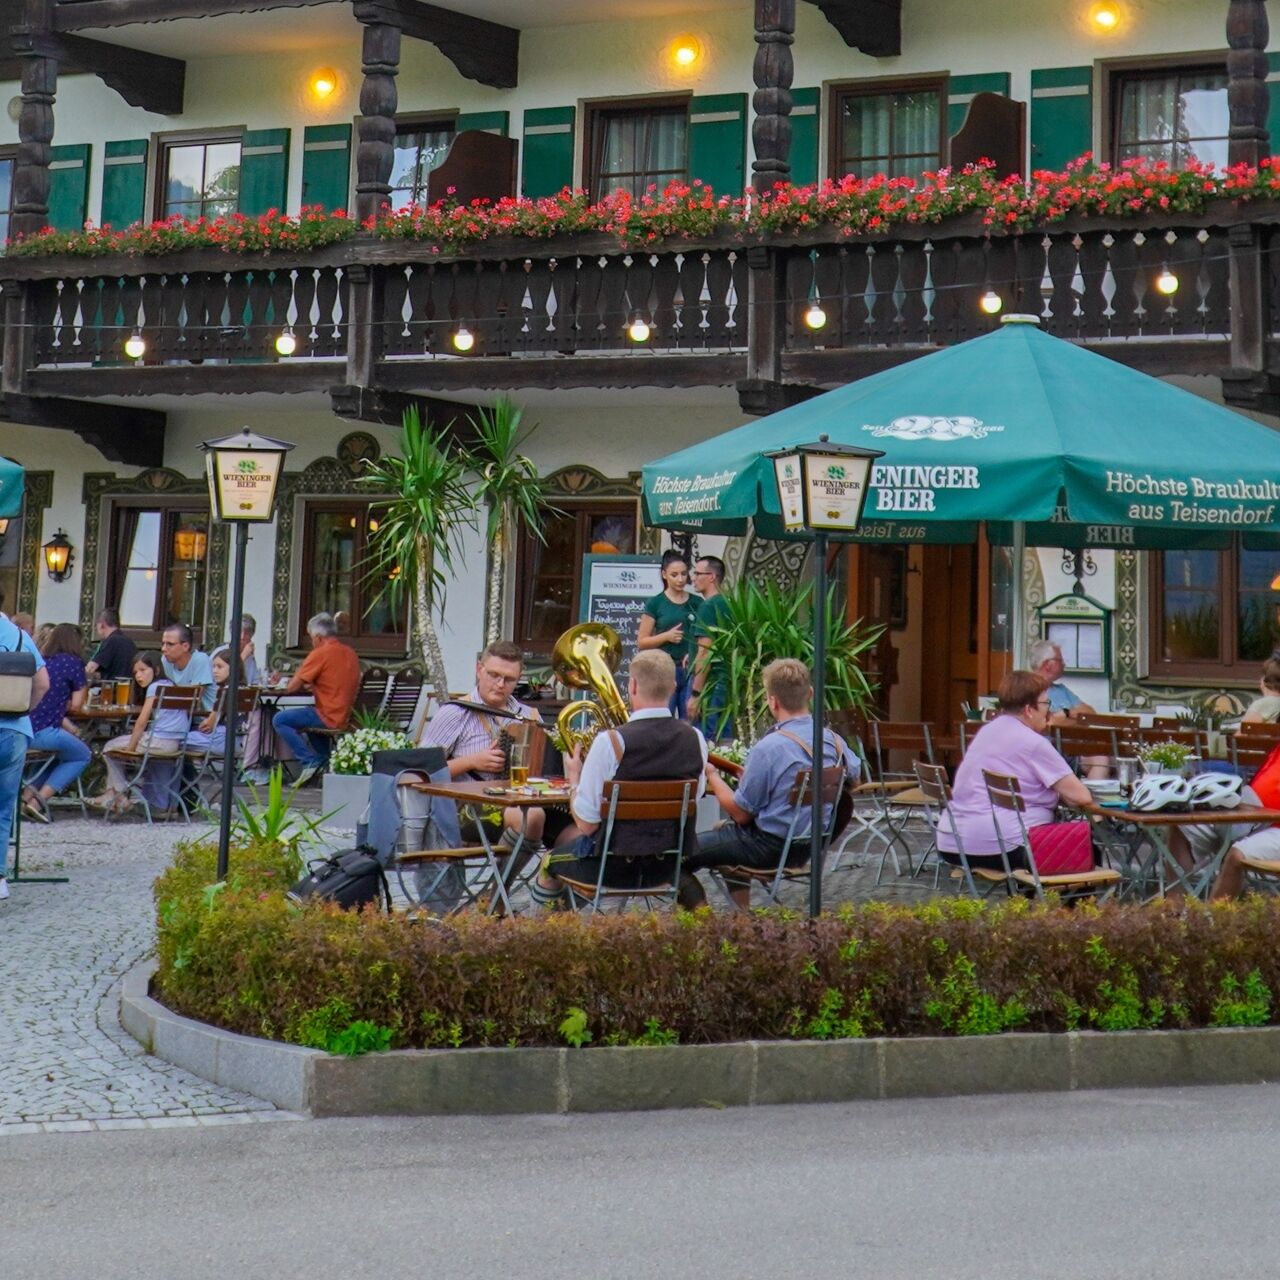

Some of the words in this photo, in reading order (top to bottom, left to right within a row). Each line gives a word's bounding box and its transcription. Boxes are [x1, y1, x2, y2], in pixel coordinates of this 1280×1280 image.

[652, 476, 692, 494] Höchste
[690, 470, 737, 492] Braukultur
[812, 479, 860, 489] WIENINGER
[869, 465, 981, 489] ENINGER
[1106, 471, 1188, 496] Höchste
[659, 502, 673, 516] aus
[674, 491, 721, 515] Teisendorf.
[876, 489, 936, 512] BIER
[1128, 503, 1164, 520] aus
[1171, 501, 1274, 524] Teisendorf.
